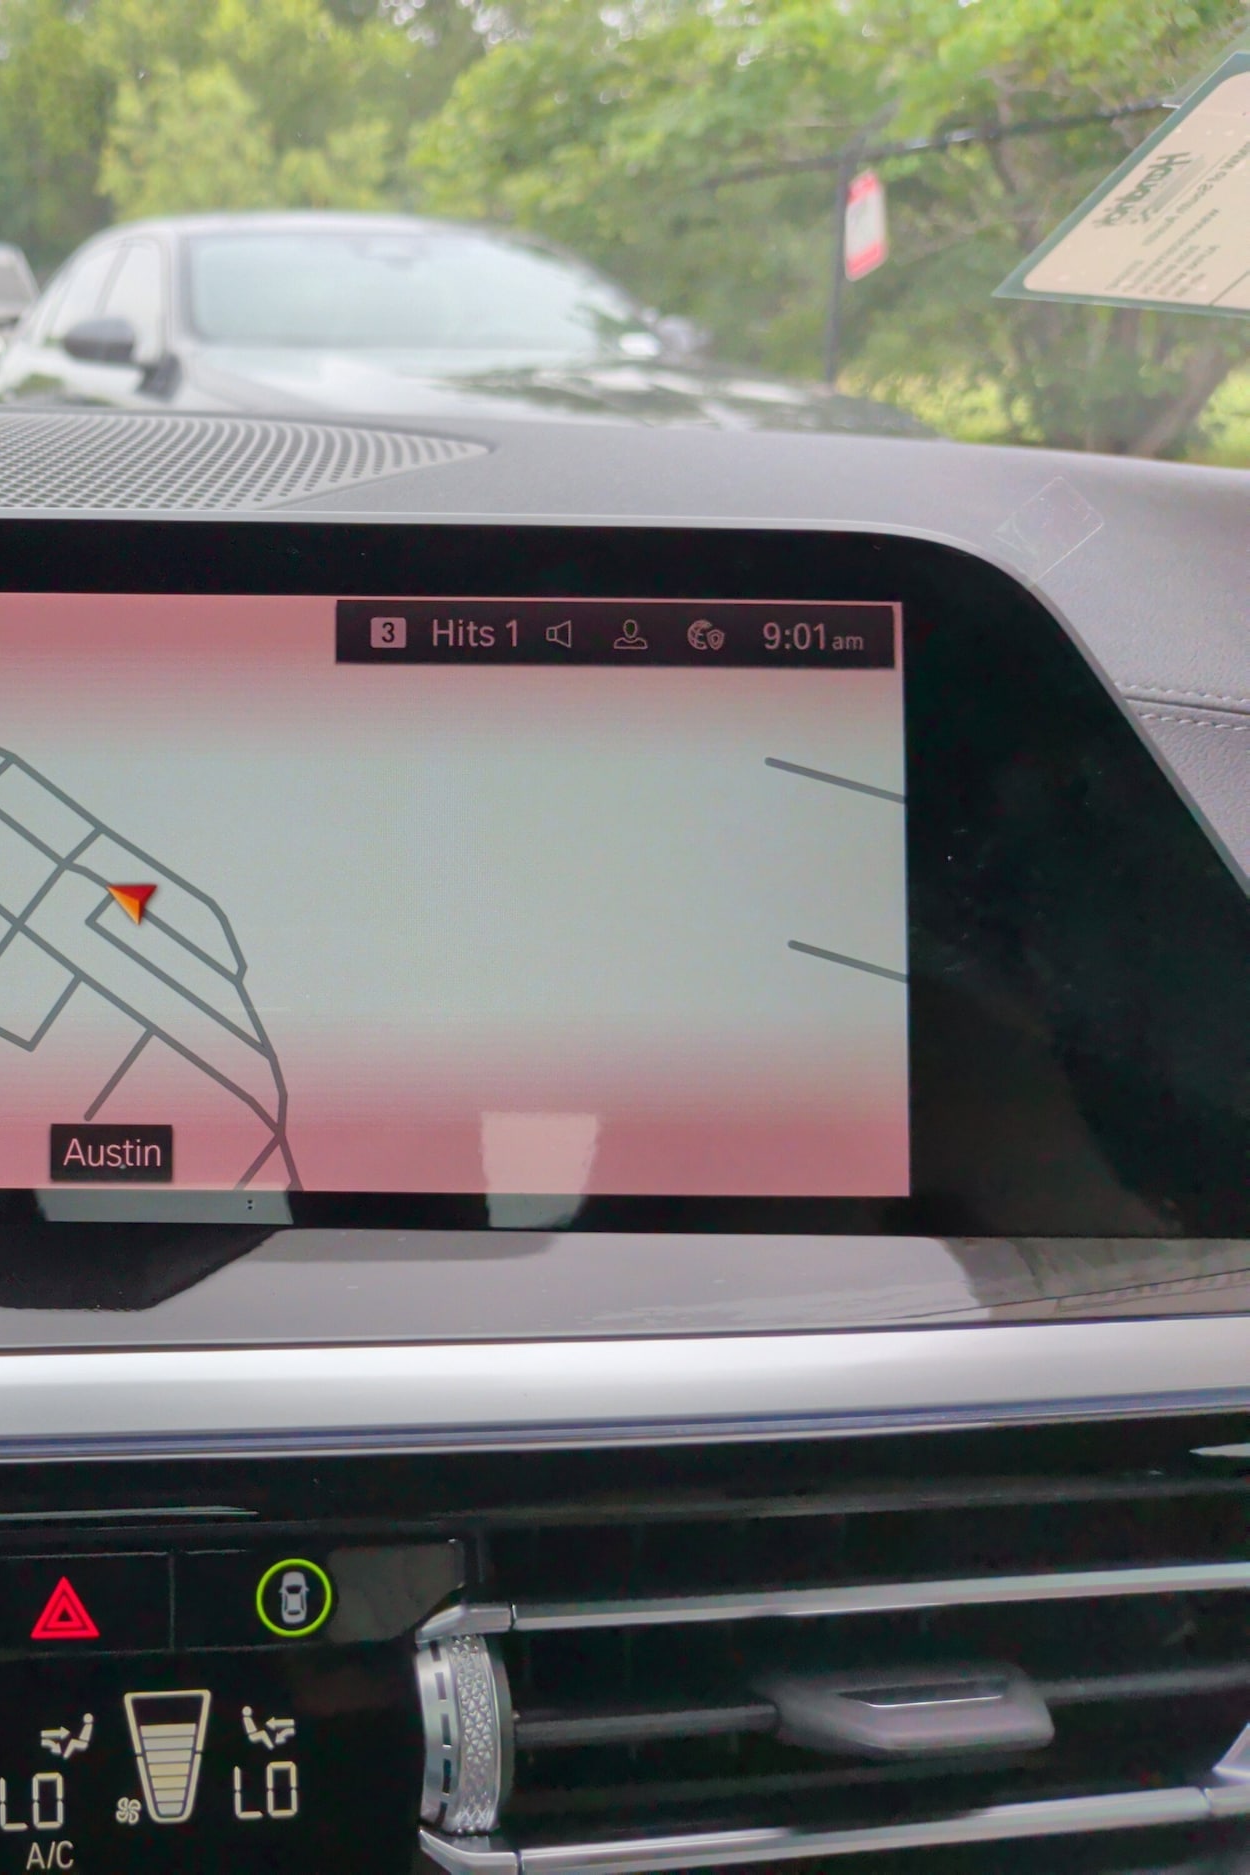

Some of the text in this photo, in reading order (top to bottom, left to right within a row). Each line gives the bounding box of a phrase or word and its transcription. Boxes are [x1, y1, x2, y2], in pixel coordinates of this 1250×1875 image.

[381, 618, 519, 648] 3 Hits 1
[62, 1137, 162, 1168] Austin
[25, 1840, 75, 1870] A/C
